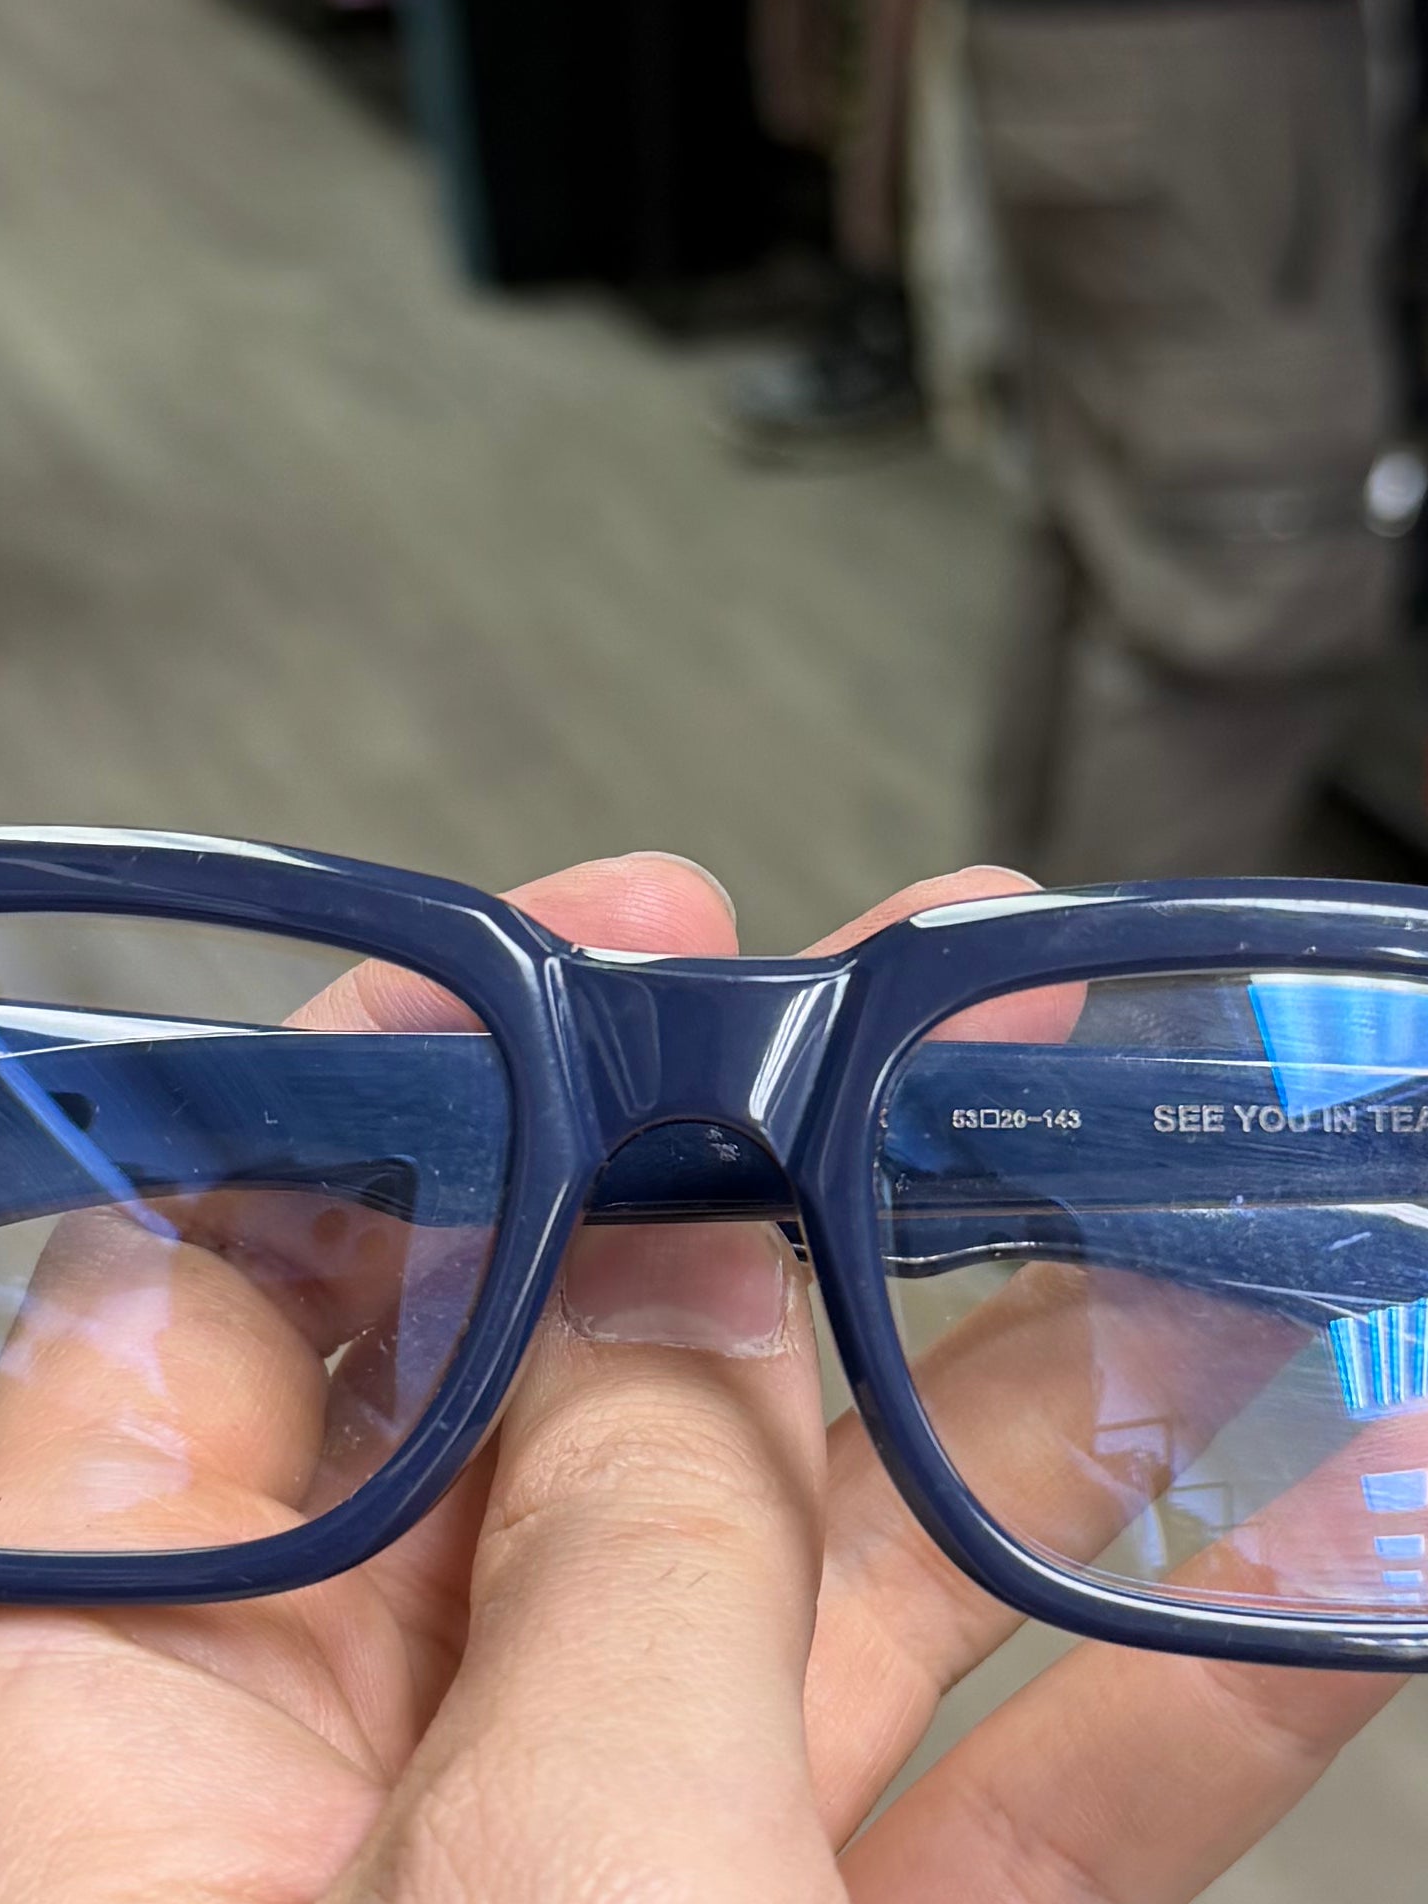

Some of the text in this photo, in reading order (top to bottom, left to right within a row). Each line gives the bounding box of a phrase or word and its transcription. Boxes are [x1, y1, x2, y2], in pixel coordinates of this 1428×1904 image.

[1153, 1104, 1225, 1133] SEE
[1233, 1104, 1310, 1133] YOU
[1322, 1105, 1357, 1133] IN
